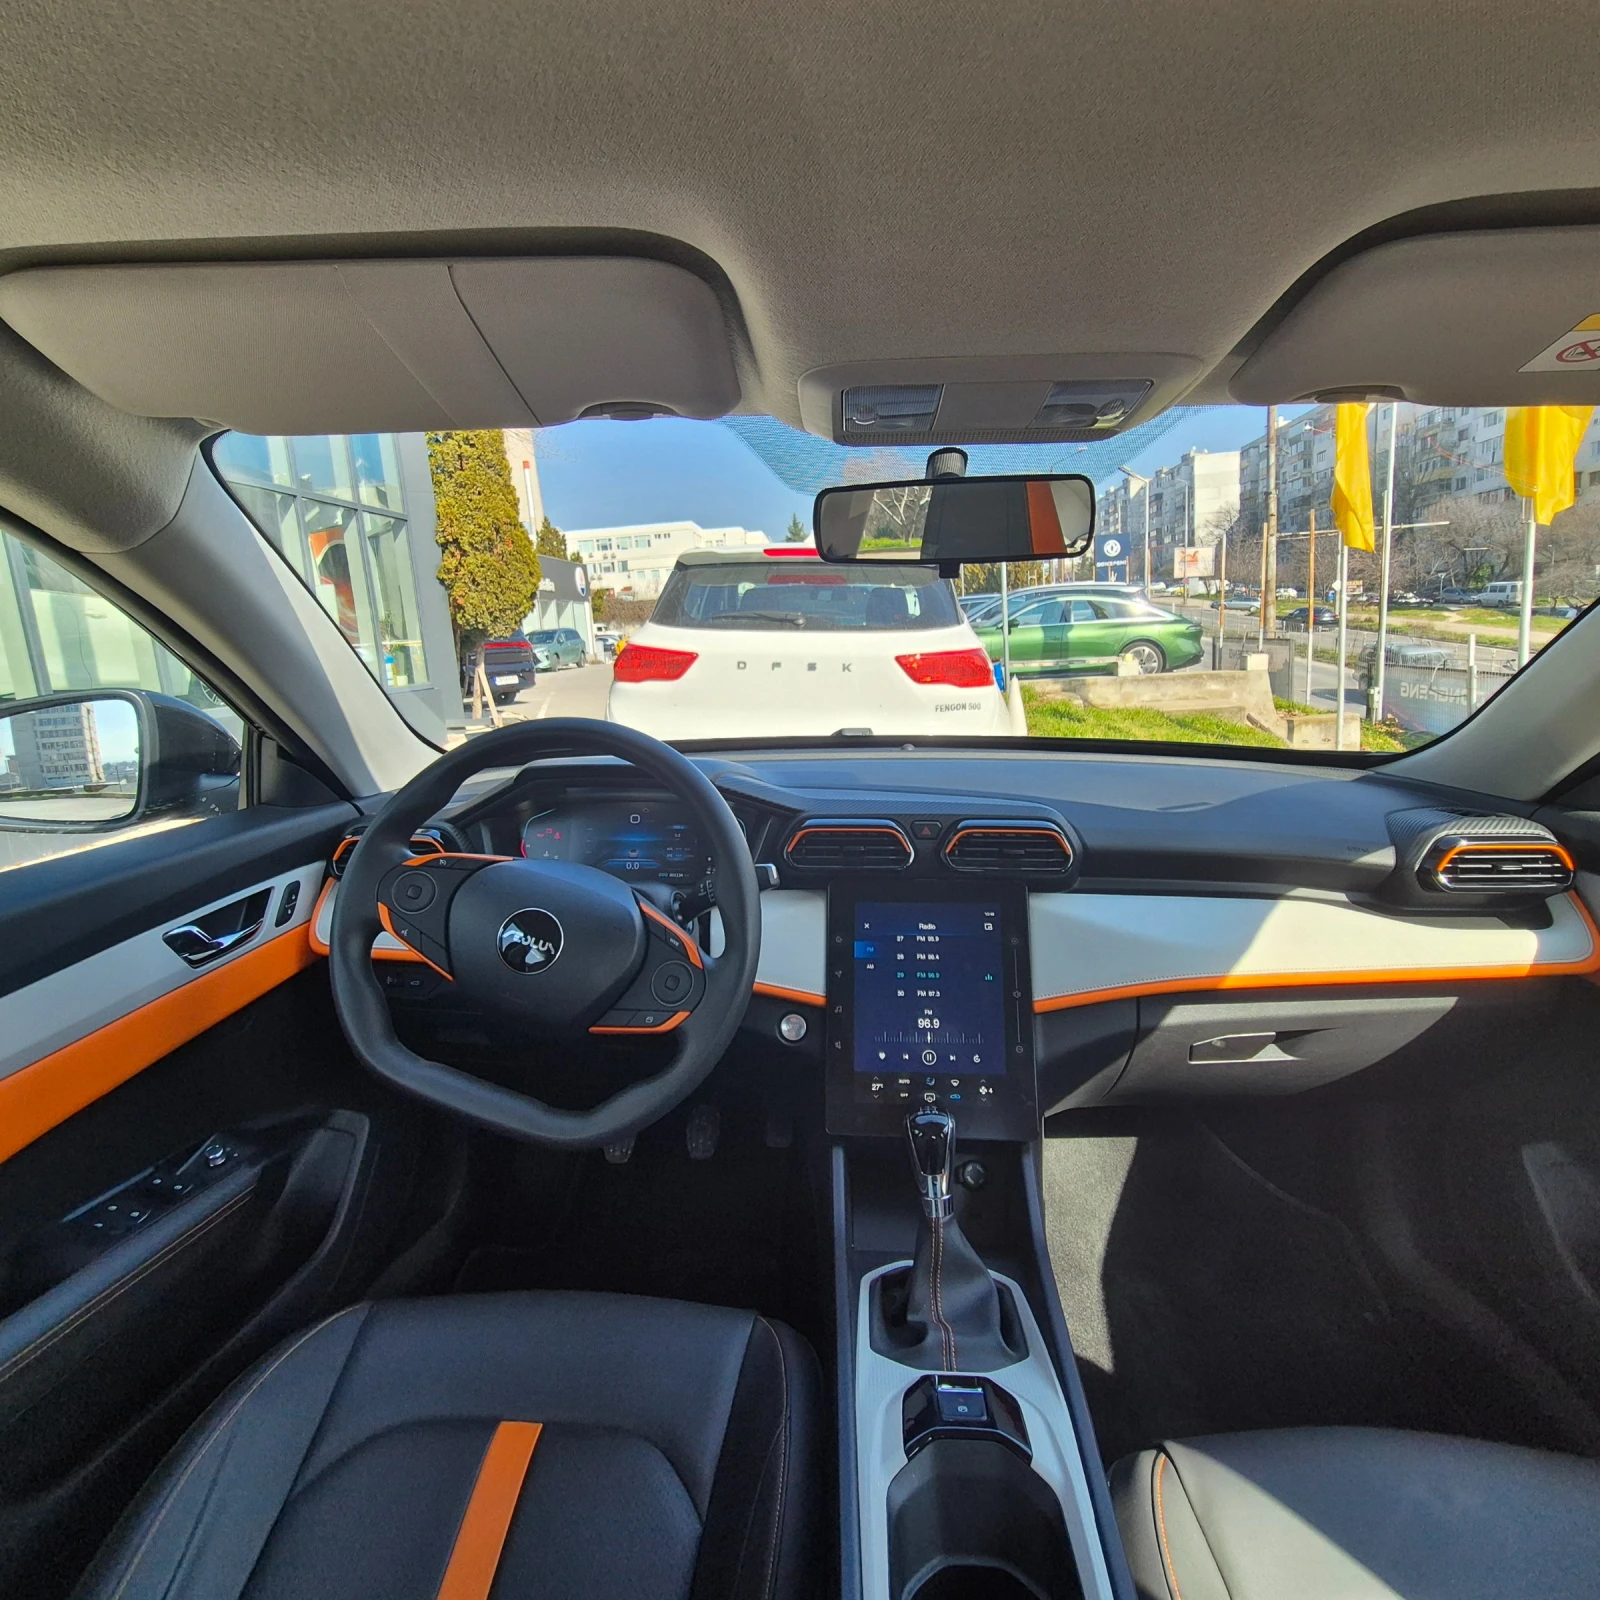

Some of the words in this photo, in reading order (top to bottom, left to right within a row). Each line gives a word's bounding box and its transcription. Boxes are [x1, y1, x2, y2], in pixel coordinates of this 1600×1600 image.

[935, 703, 967, 713] FENGON
[968, 702, 982, 711] 500
[626, 862, 640, 870] 0.0
[918, 923, 936, 931] Radio
[917, 1018, 940, 1029] 96.9
